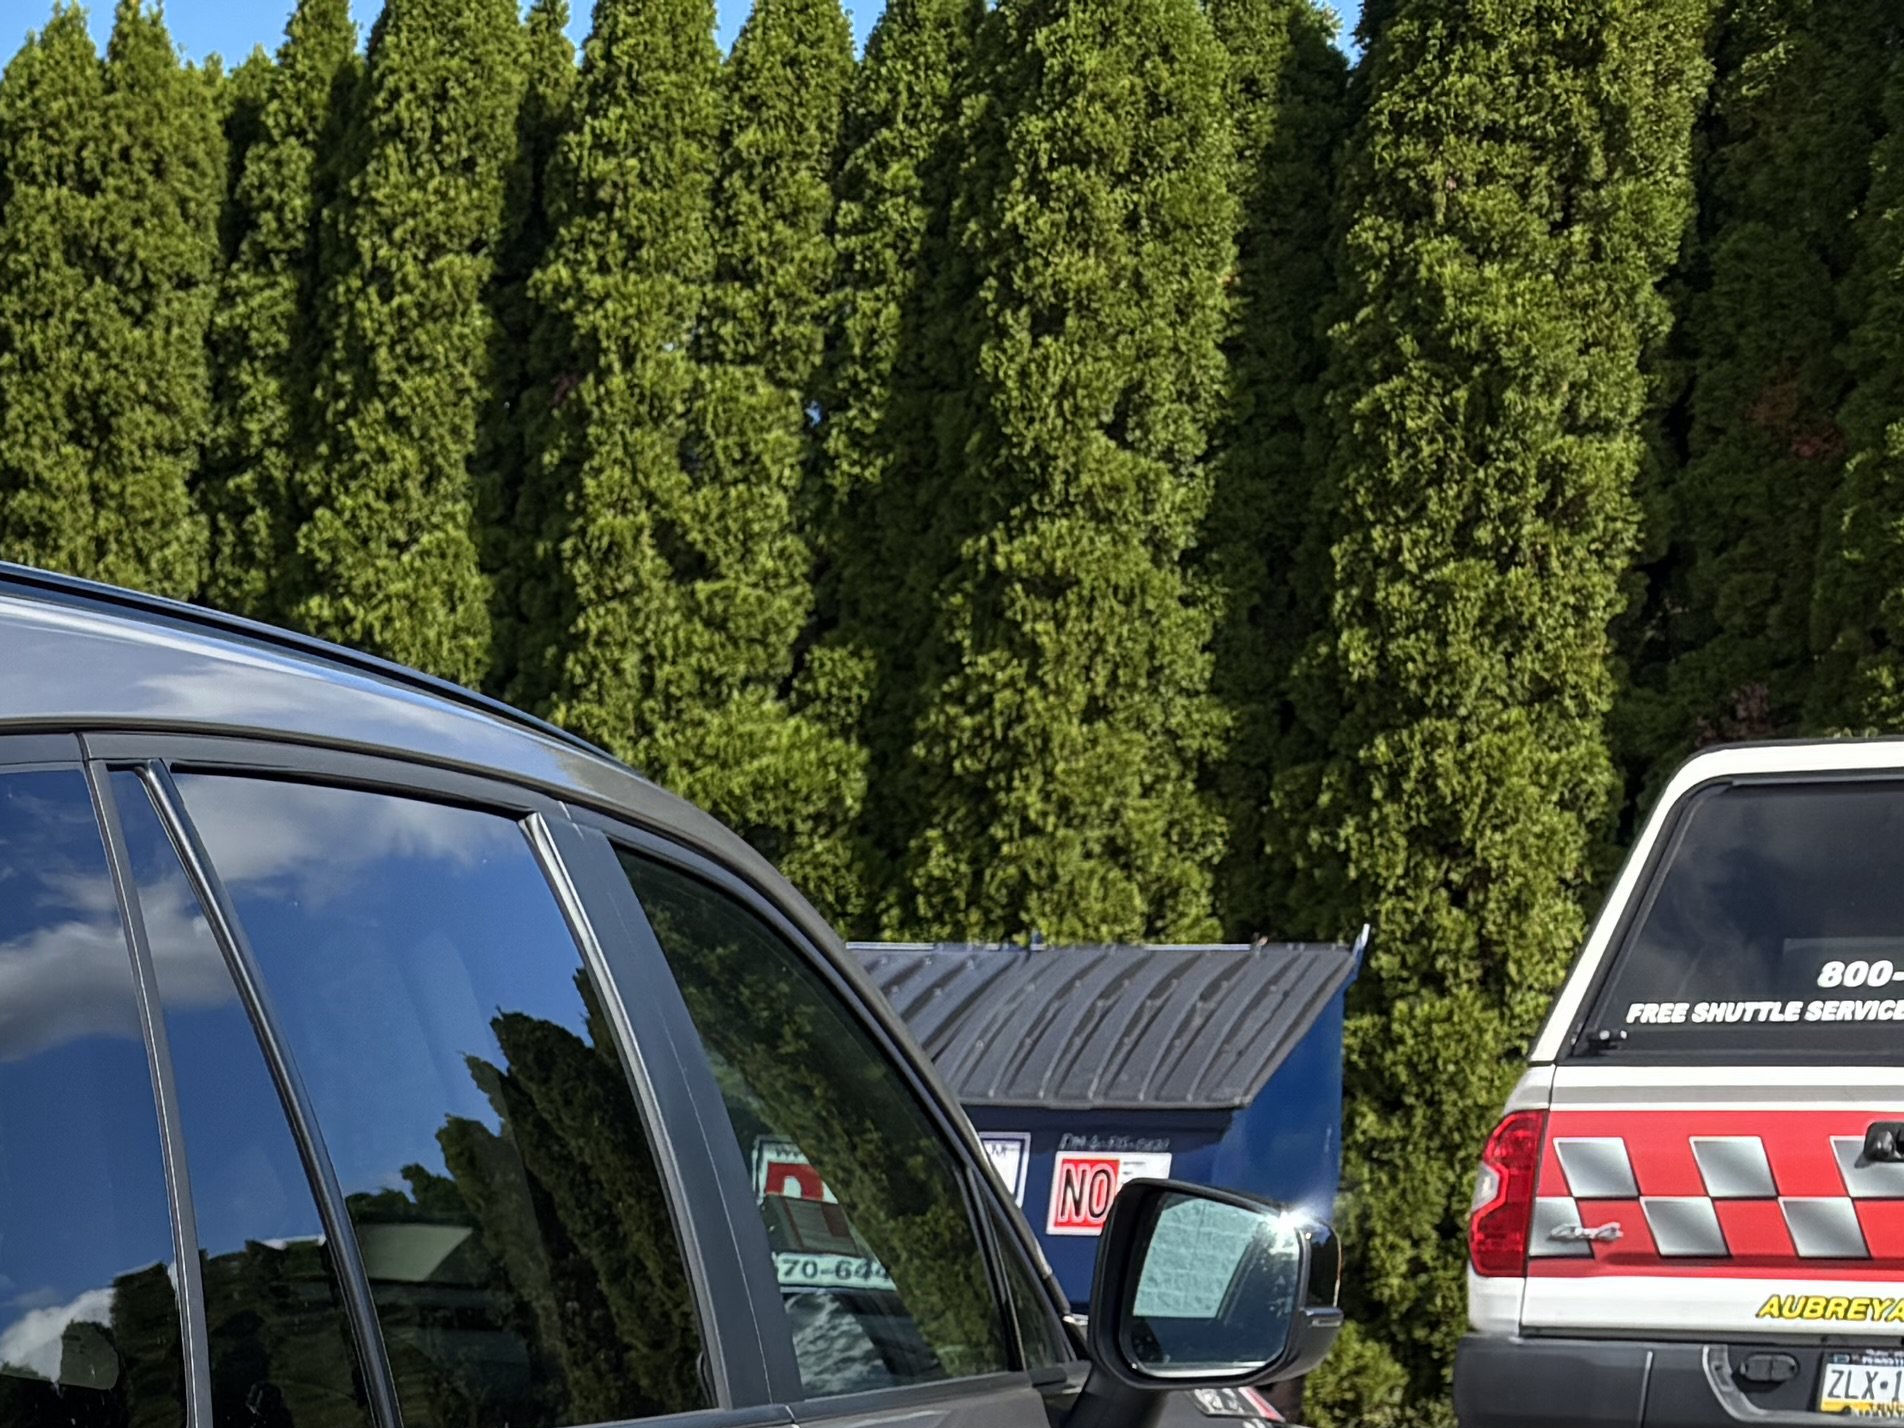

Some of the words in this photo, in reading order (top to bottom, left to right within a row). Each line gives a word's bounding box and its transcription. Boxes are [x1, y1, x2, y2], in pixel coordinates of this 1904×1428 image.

[1626, 1003, 1689, 1024] FREE
[1691, 1002, 1803, 1023] SHUTTLE
[1804, 1000, 1904, 1021] SERVICE
[1058, 1164, 1114, 1223] NO
